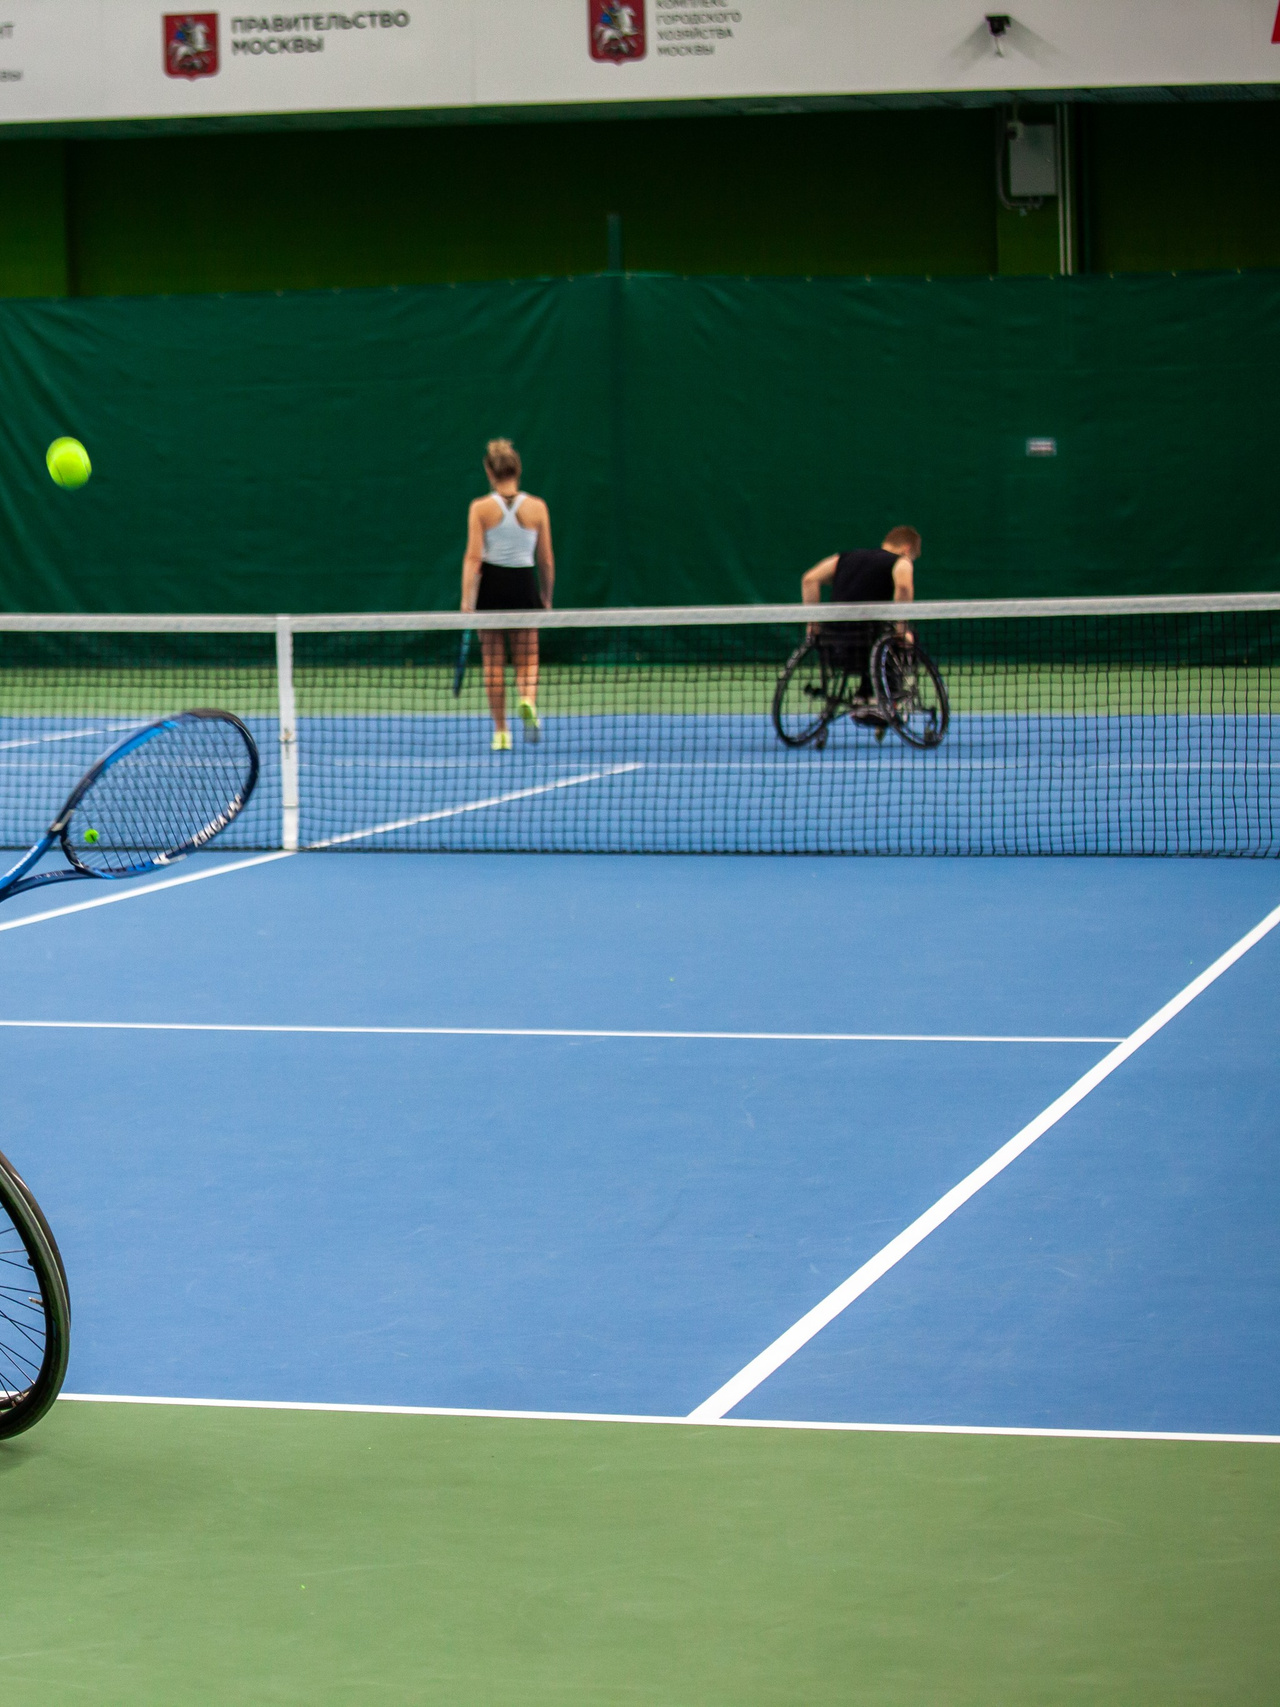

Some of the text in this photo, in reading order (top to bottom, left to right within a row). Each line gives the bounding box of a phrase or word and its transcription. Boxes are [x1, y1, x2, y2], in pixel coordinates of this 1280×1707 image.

[231, 9, 410, 34] ПРАВИТЕЛЬСТВО
[656, 10, 742, 25] ГОРОДСКОГО
[657, 26, 734, 41] ХОЗЯЙСТВА
[231, 36, 324, 56] МОСКВЫ
[656, 43, 715, 57] МОСКВЫ
